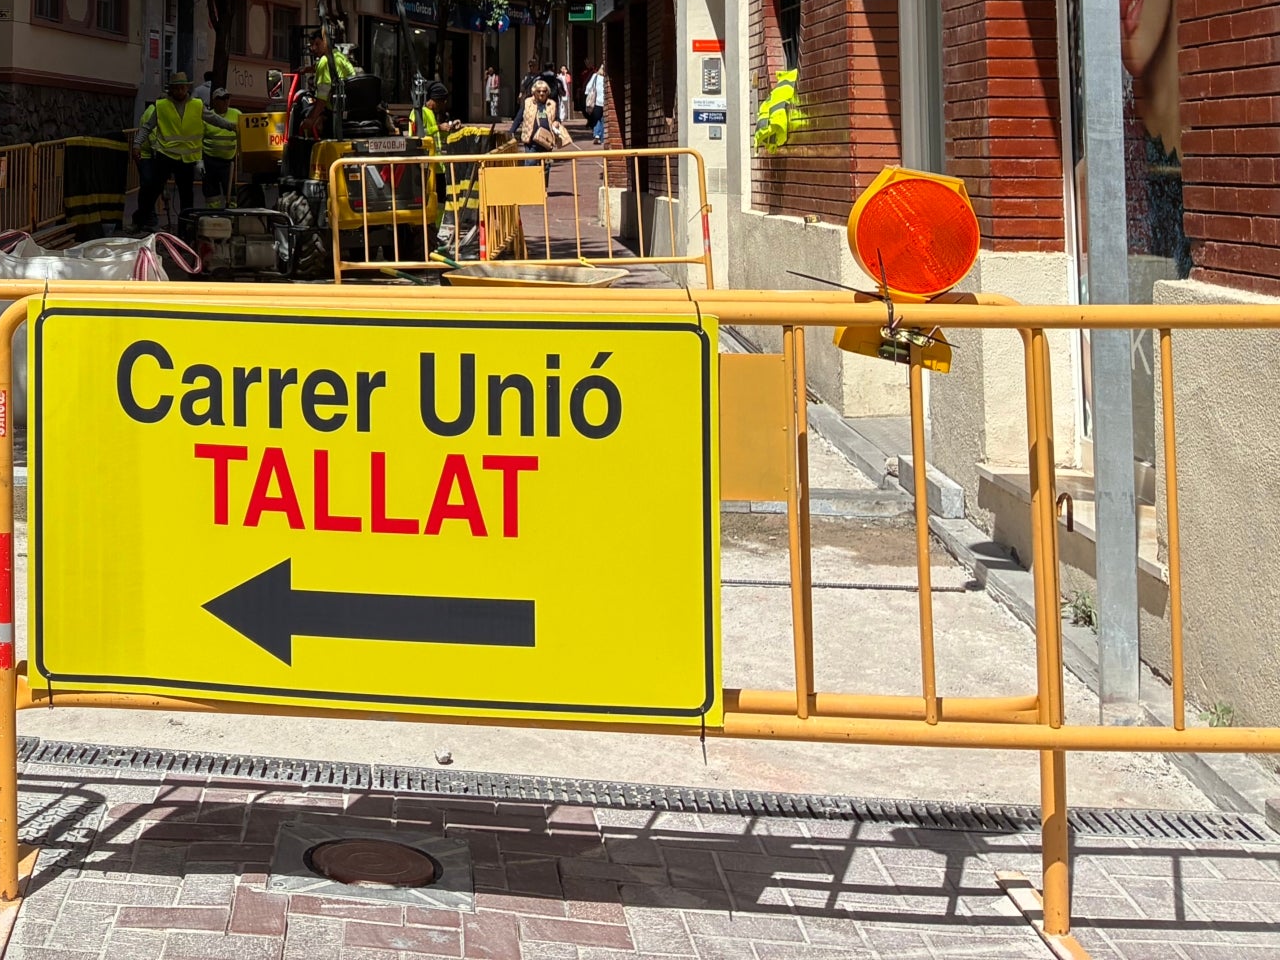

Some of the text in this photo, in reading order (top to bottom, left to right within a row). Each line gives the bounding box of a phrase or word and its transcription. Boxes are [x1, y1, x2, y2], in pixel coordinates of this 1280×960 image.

[116, 339, 623, 440] Carrer Unió
[194, 443, 539, 538] TALLAT
